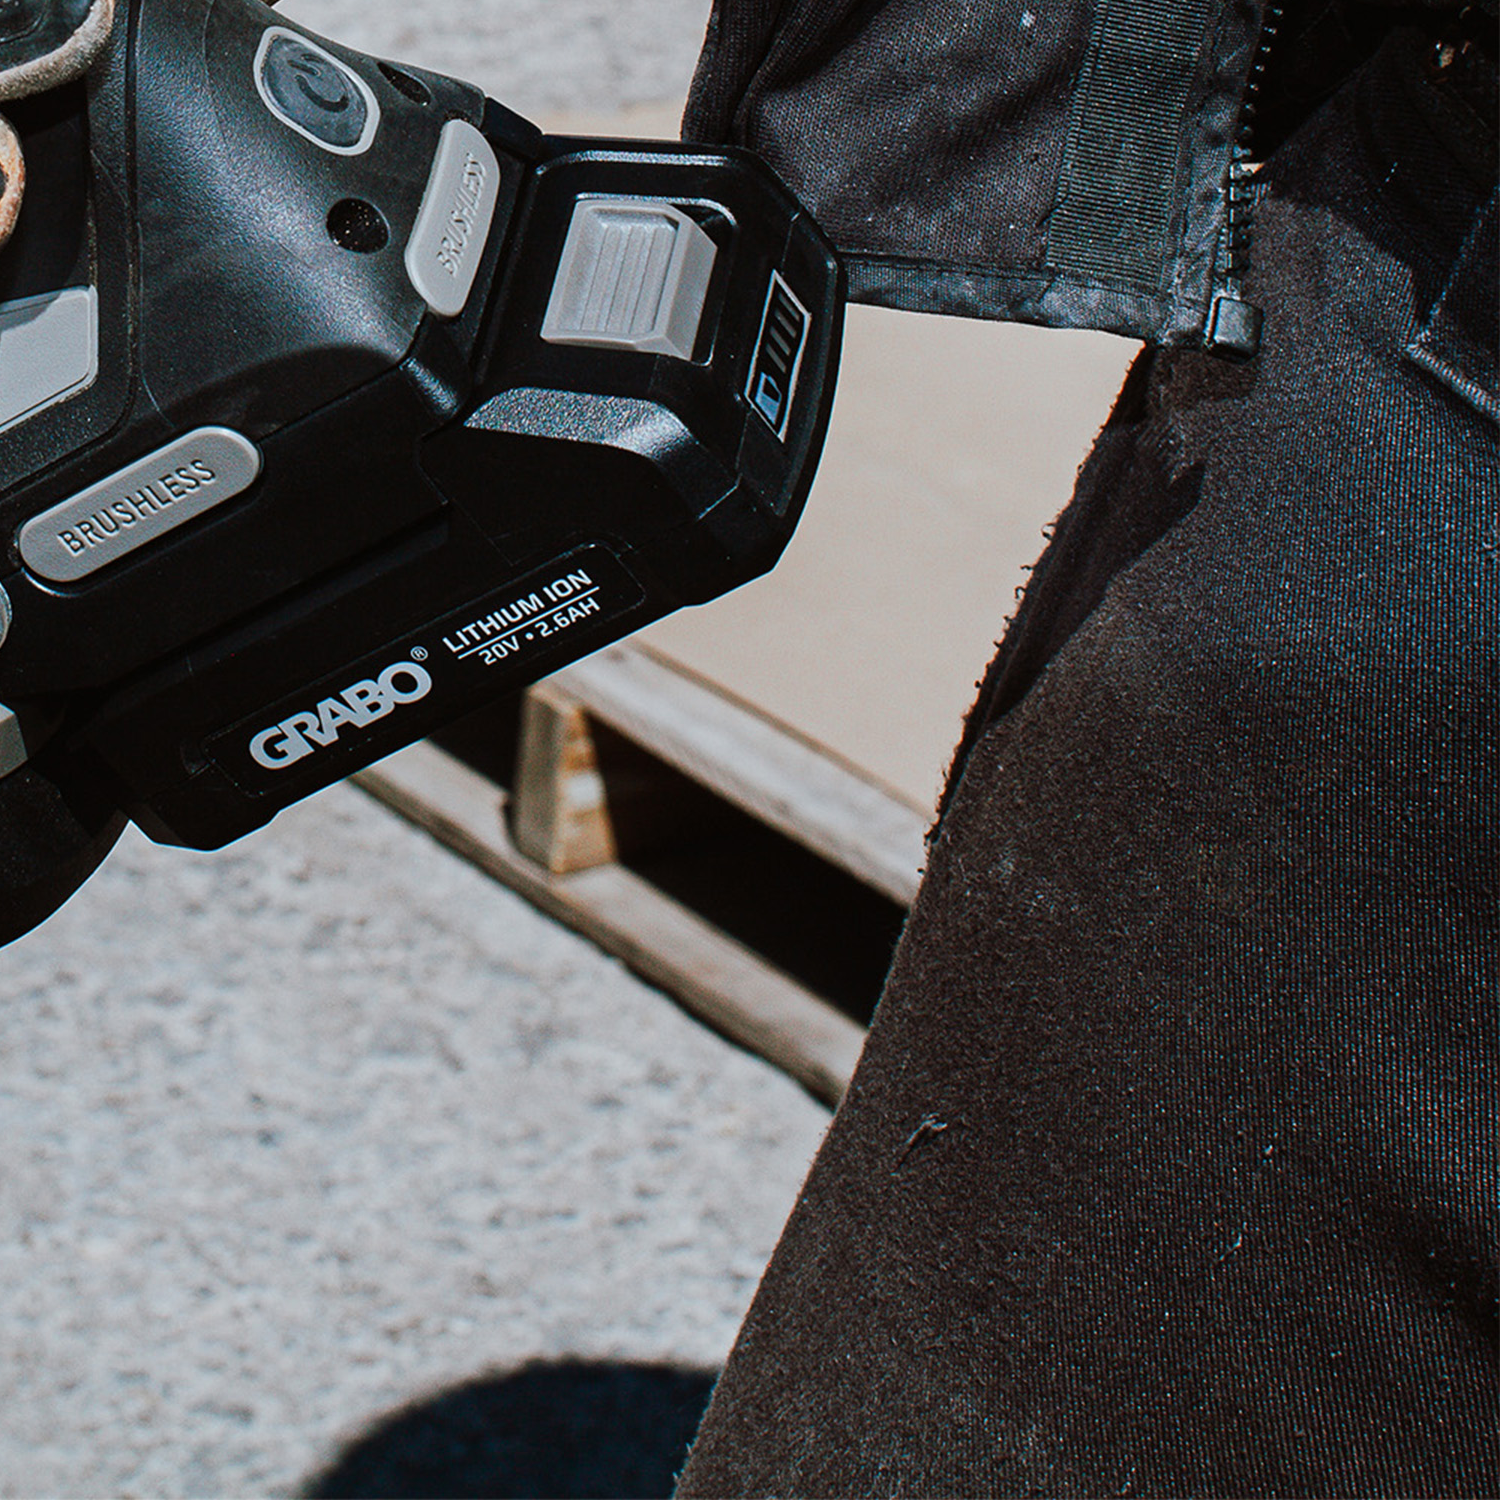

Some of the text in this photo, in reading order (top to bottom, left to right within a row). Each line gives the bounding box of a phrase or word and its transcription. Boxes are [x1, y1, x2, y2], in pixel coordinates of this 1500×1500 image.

[436, 152, 486, 277] BRUSHLESS
[57, 459, 216, 556] BRUSHLESS
[442, 568, 593, 653] LITHIUM ION
[478, 635, 520, 666] 20V
[534, 597, 601, 638] 2.6AH
